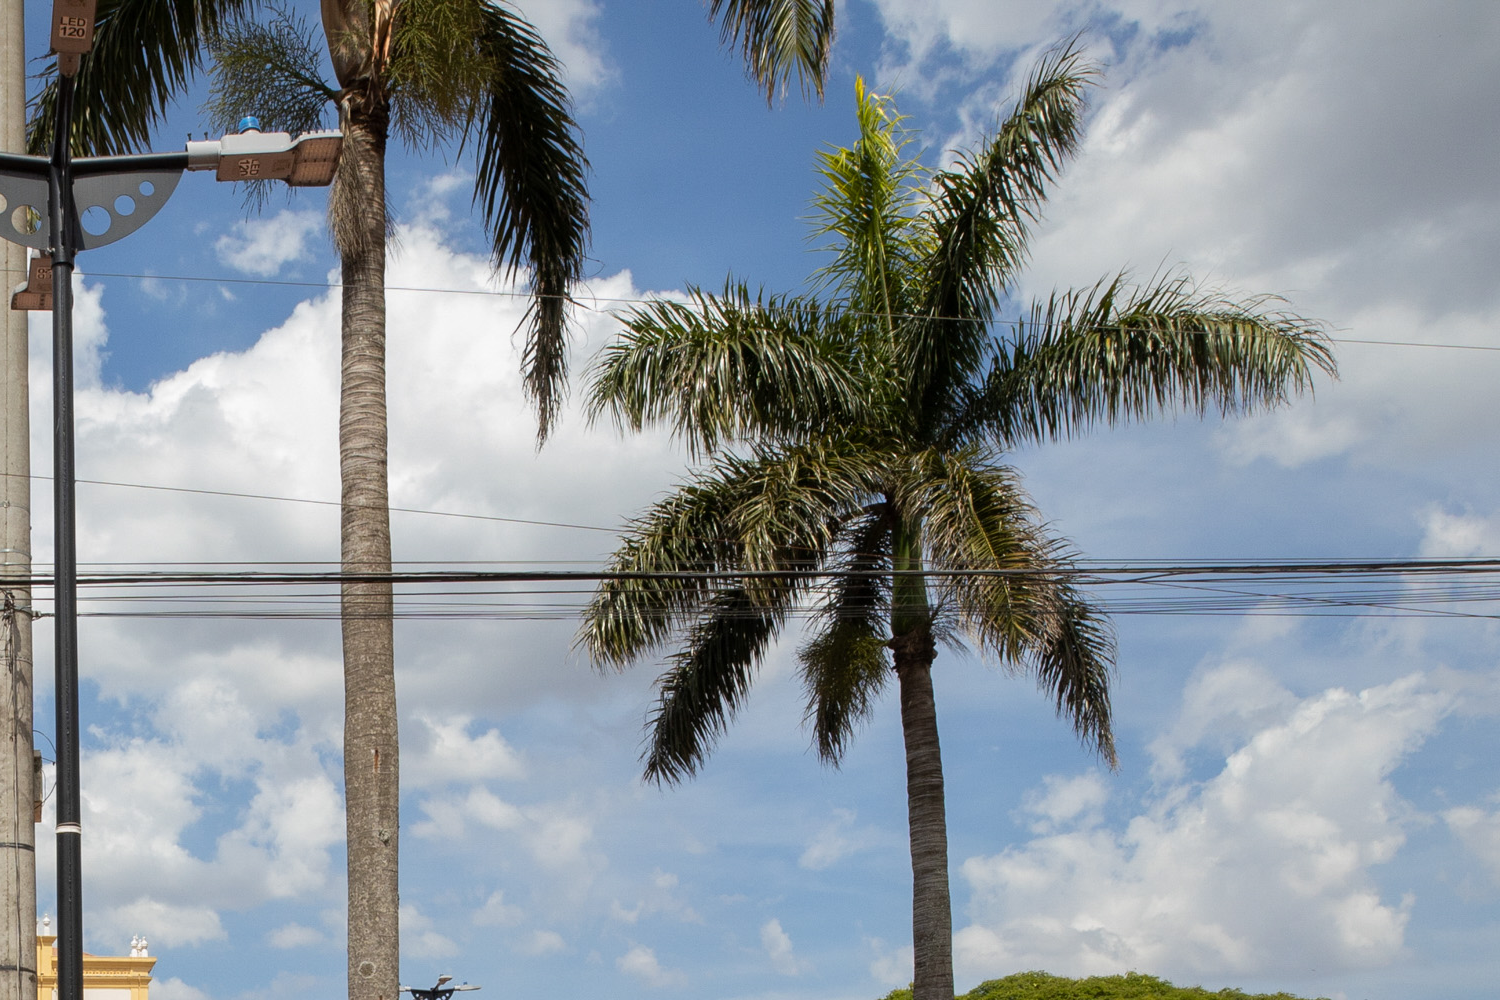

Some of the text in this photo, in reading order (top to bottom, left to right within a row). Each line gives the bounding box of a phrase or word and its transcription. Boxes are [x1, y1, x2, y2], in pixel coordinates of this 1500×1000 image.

[60, 16, 86, 26] LED
[60, 26, 85, 37] 120
[239, 159, 249, 176] 120
[250, 159, 260, 176] LED
